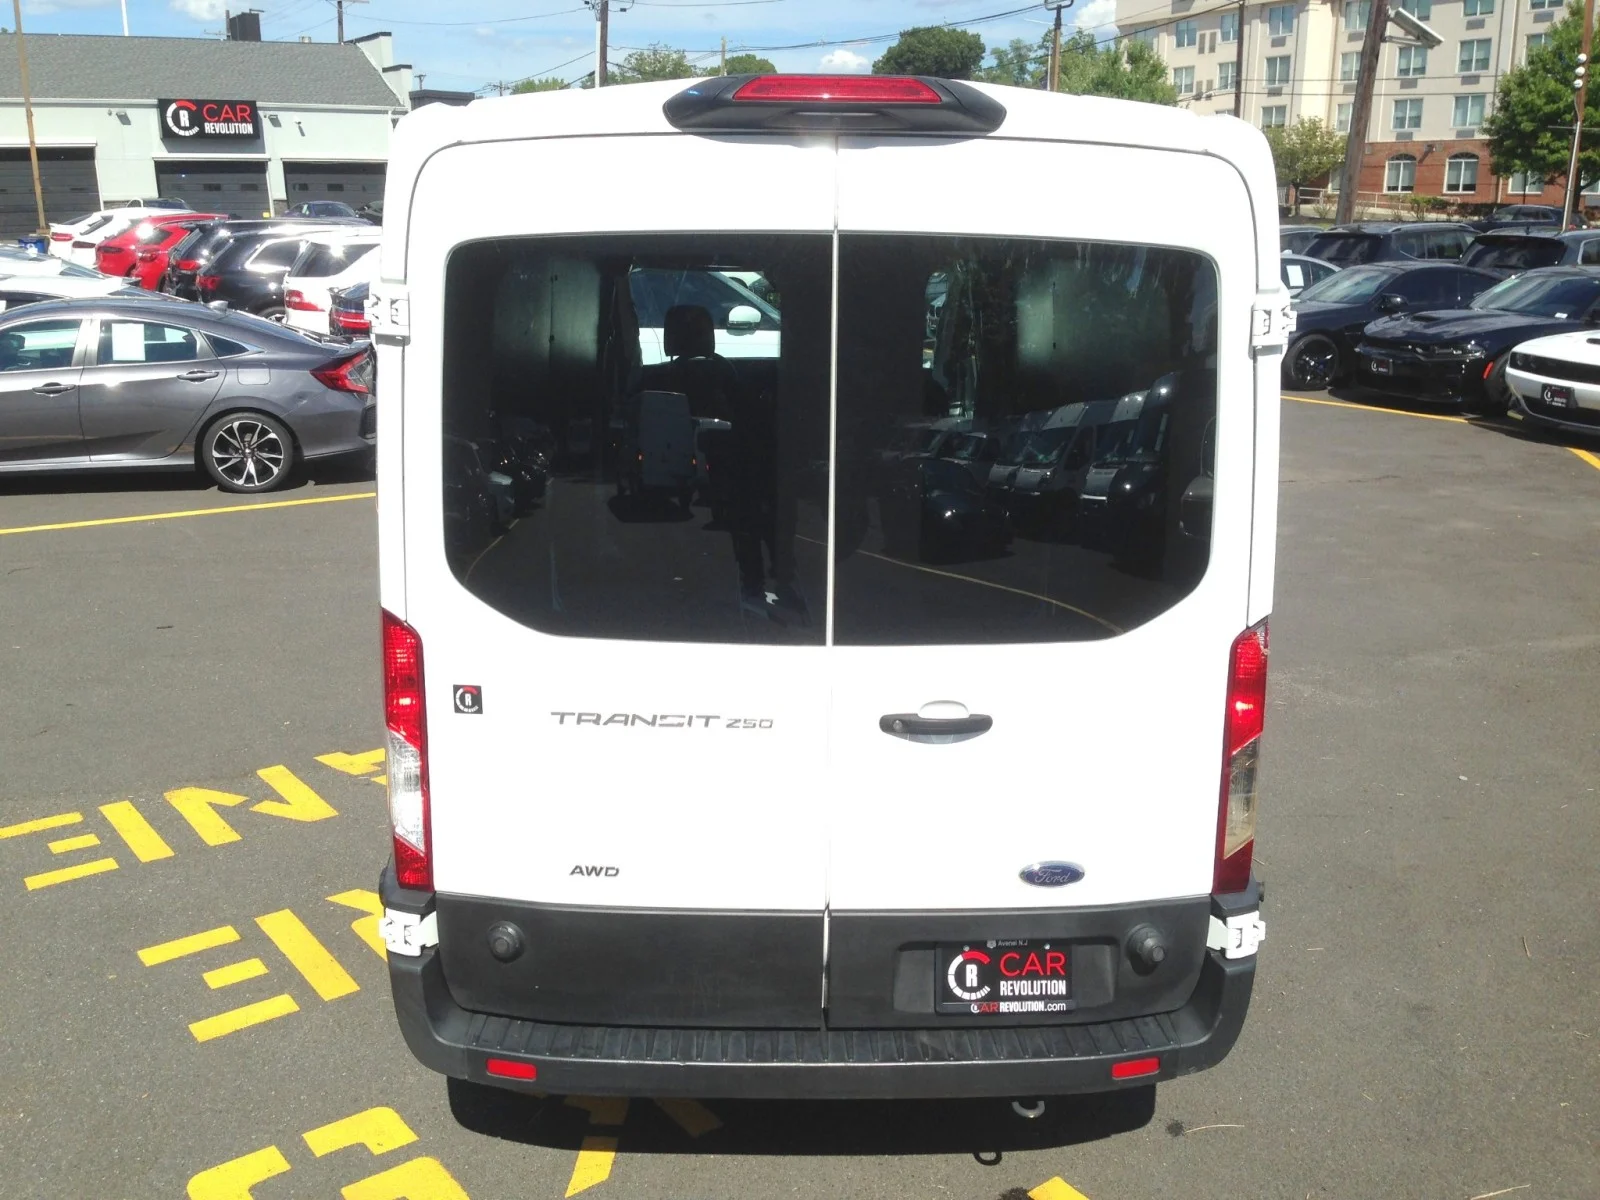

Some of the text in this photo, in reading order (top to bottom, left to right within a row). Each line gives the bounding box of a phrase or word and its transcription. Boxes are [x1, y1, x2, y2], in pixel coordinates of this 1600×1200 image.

[202, 104, 252, 122] CAR
[204, 122, 254, 135] REVOLUTION
[551, 711, 774, 729] TRANSIT 250
[569, 865, 620, 878] AWD
[999, 952, 1067, 977] CAR
[1000, 979, 1066, 996] REVOLUTION
